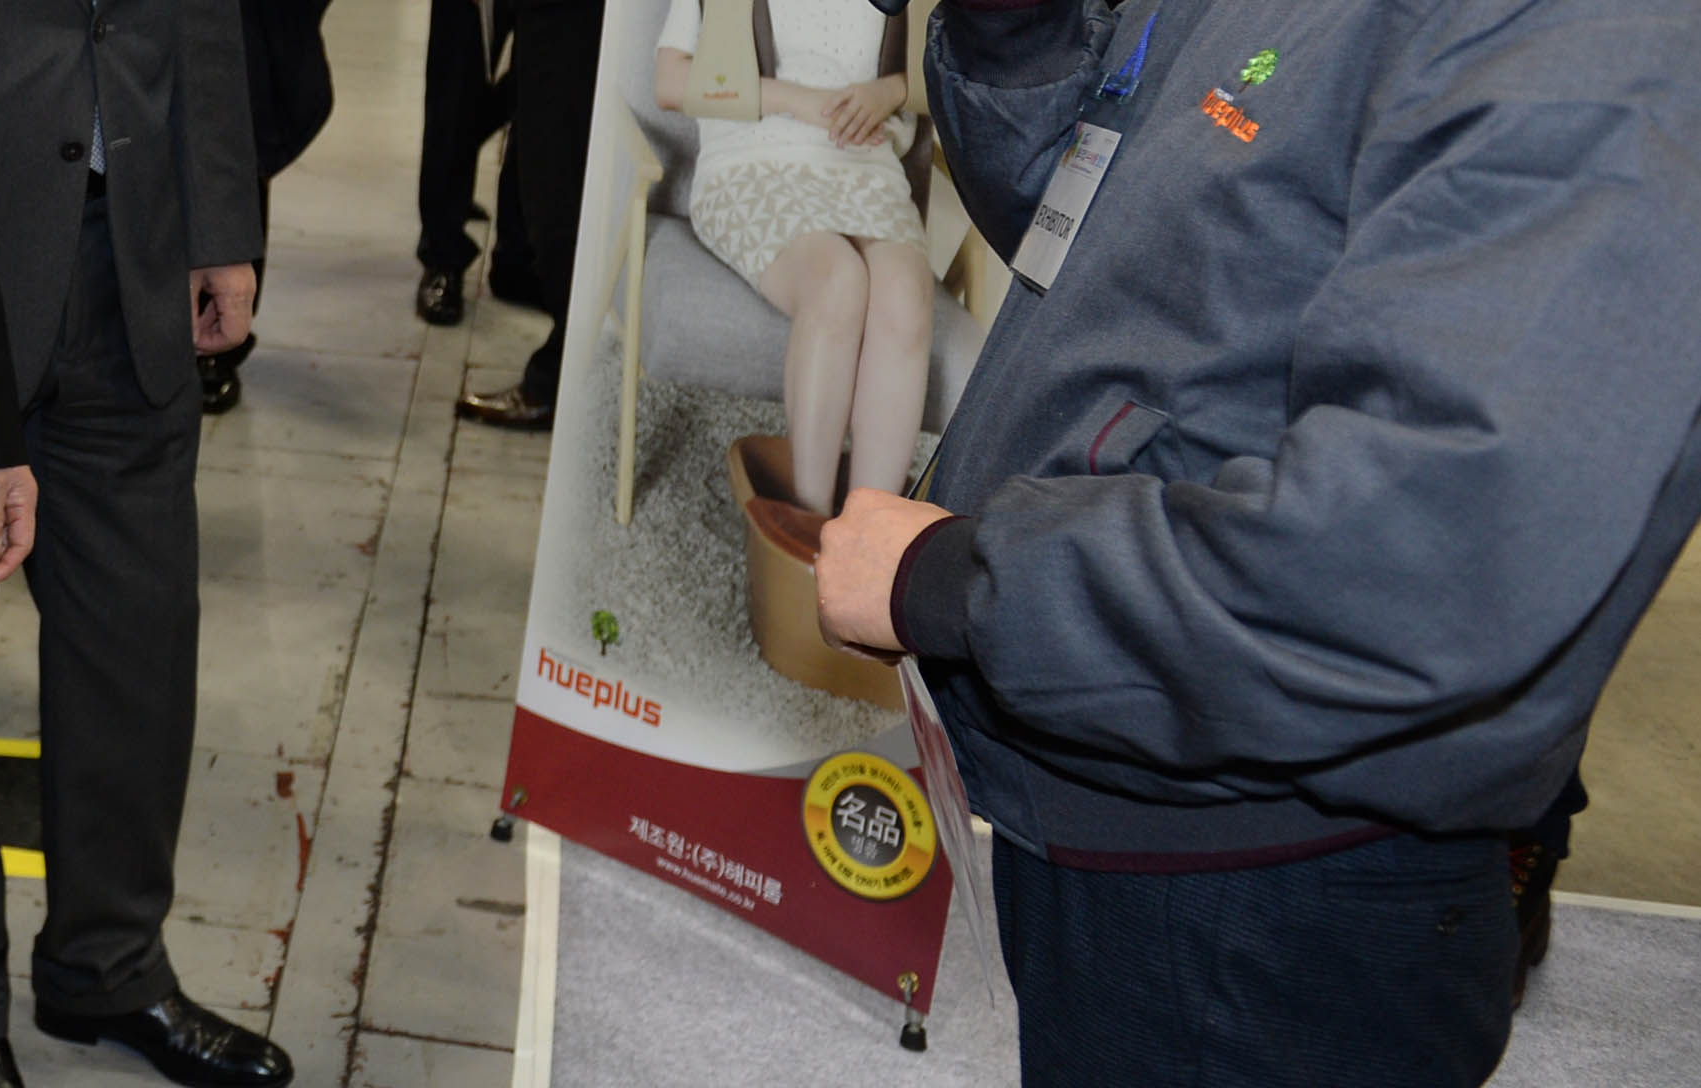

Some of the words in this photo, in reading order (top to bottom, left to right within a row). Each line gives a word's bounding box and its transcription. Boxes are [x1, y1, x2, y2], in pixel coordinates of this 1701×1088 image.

[1035, 204, 1075, 240] EXHIBITOR
[537, 647, 663, 727] hueplus
[836, 792, 901, 847] 名品
